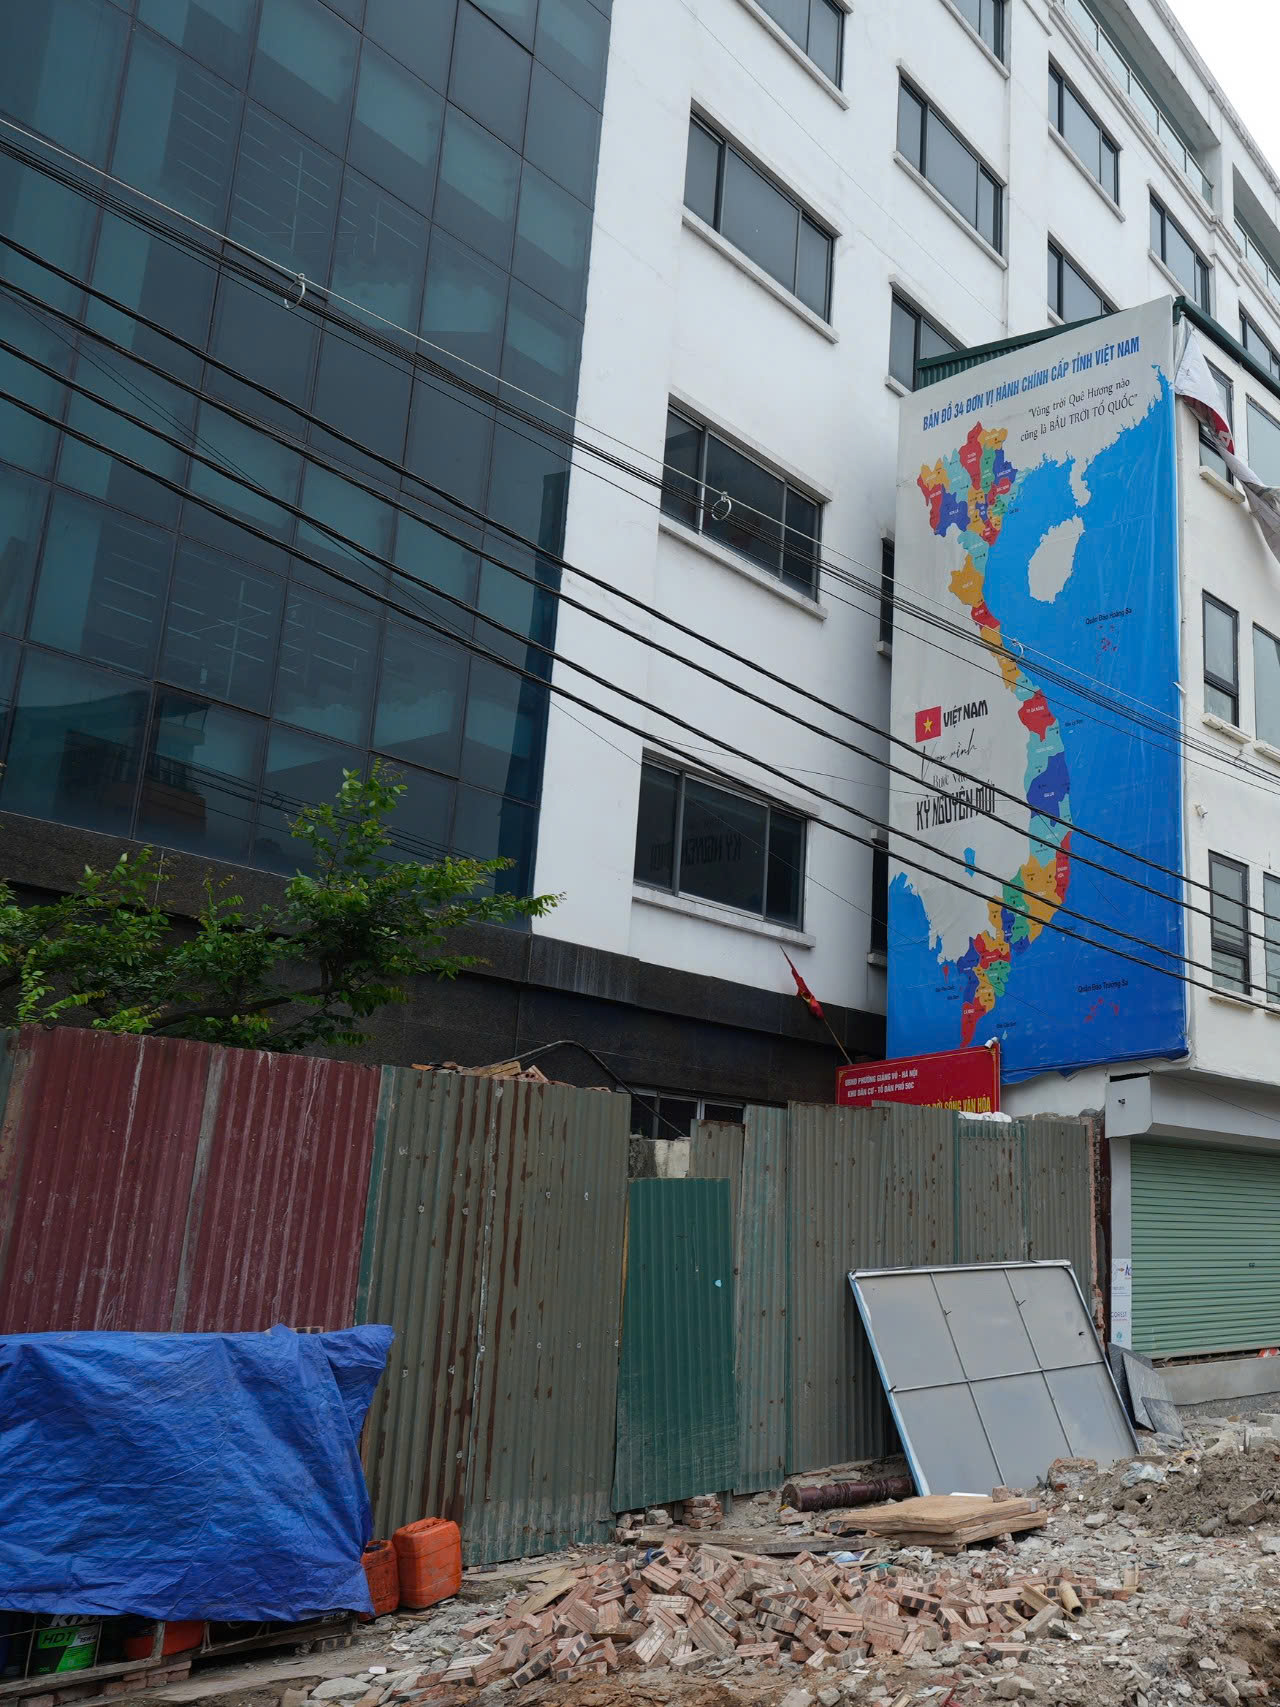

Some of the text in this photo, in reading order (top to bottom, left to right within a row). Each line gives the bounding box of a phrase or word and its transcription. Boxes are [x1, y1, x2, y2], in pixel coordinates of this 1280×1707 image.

[923, 336, 1140, 431] BẢN ĐỒ 34 ĐƠN VỊ HÀNH CHÍNH CẤP TỈNH VIỆT NAM
[943, 699, 988, 728] VIỆT NAM
[932, 785, 973, 827] NGUYÊN
[963, 1096, 976, 1112] VĂN
[978, 1093, 991, 1112] HÓA
